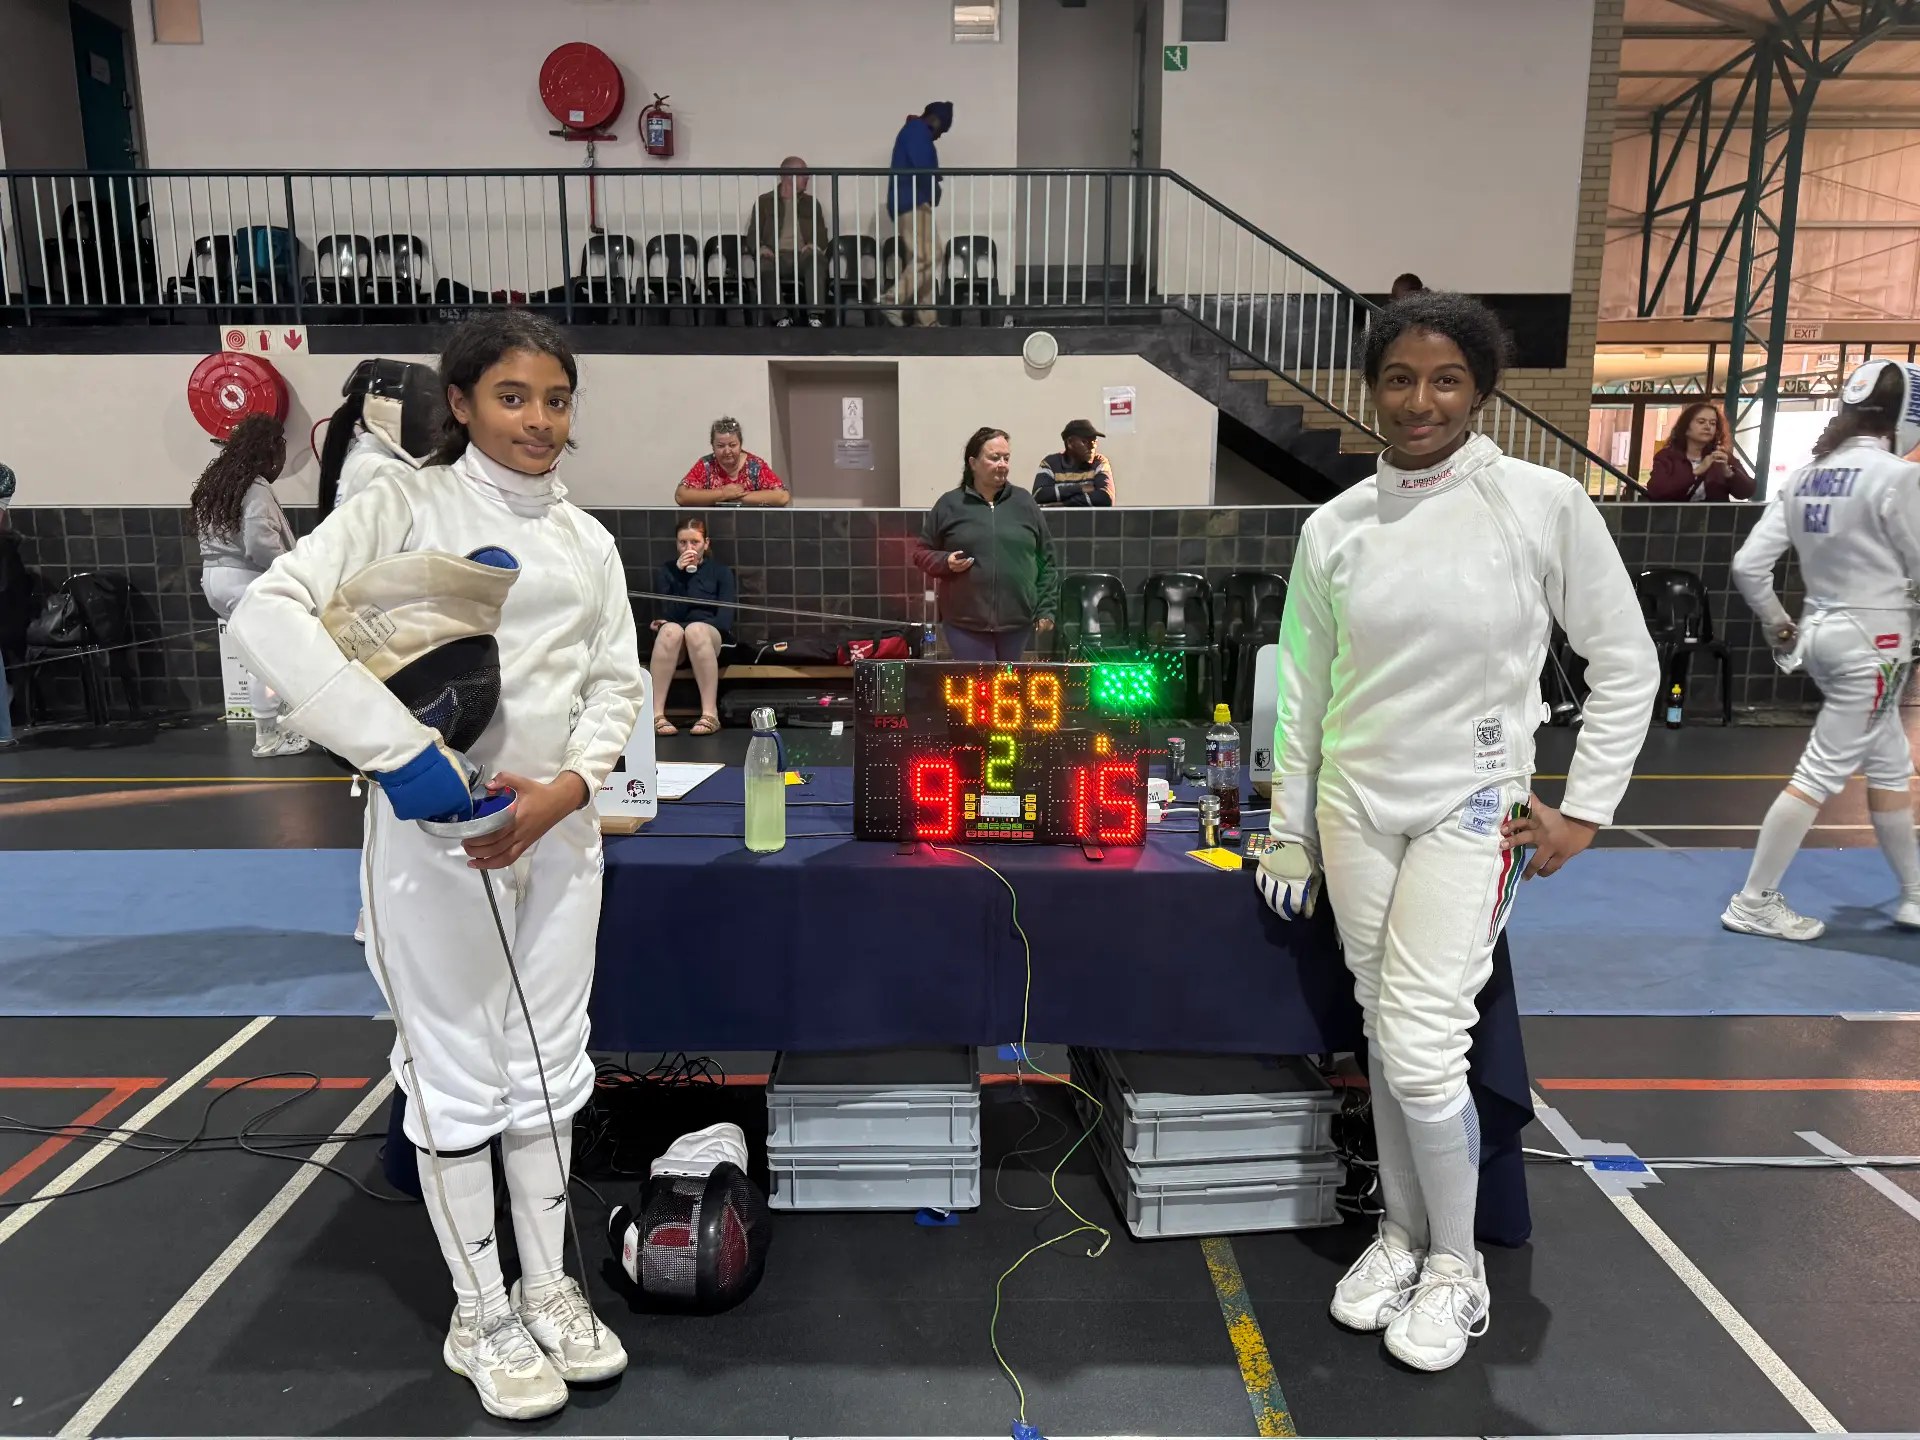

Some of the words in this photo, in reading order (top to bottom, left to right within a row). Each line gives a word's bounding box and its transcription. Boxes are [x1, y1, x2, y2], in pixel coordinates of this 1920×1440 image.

[1794, 329, 1818, 339] EXIT
[1793, 467, 1863, 497] LAMBERT
[874, 716, 909, 729] FFSA
[987, 734, 1015, 789] 2
[915, 760, 954, 837] 9
[1077, 763, 1138, 839] 15
